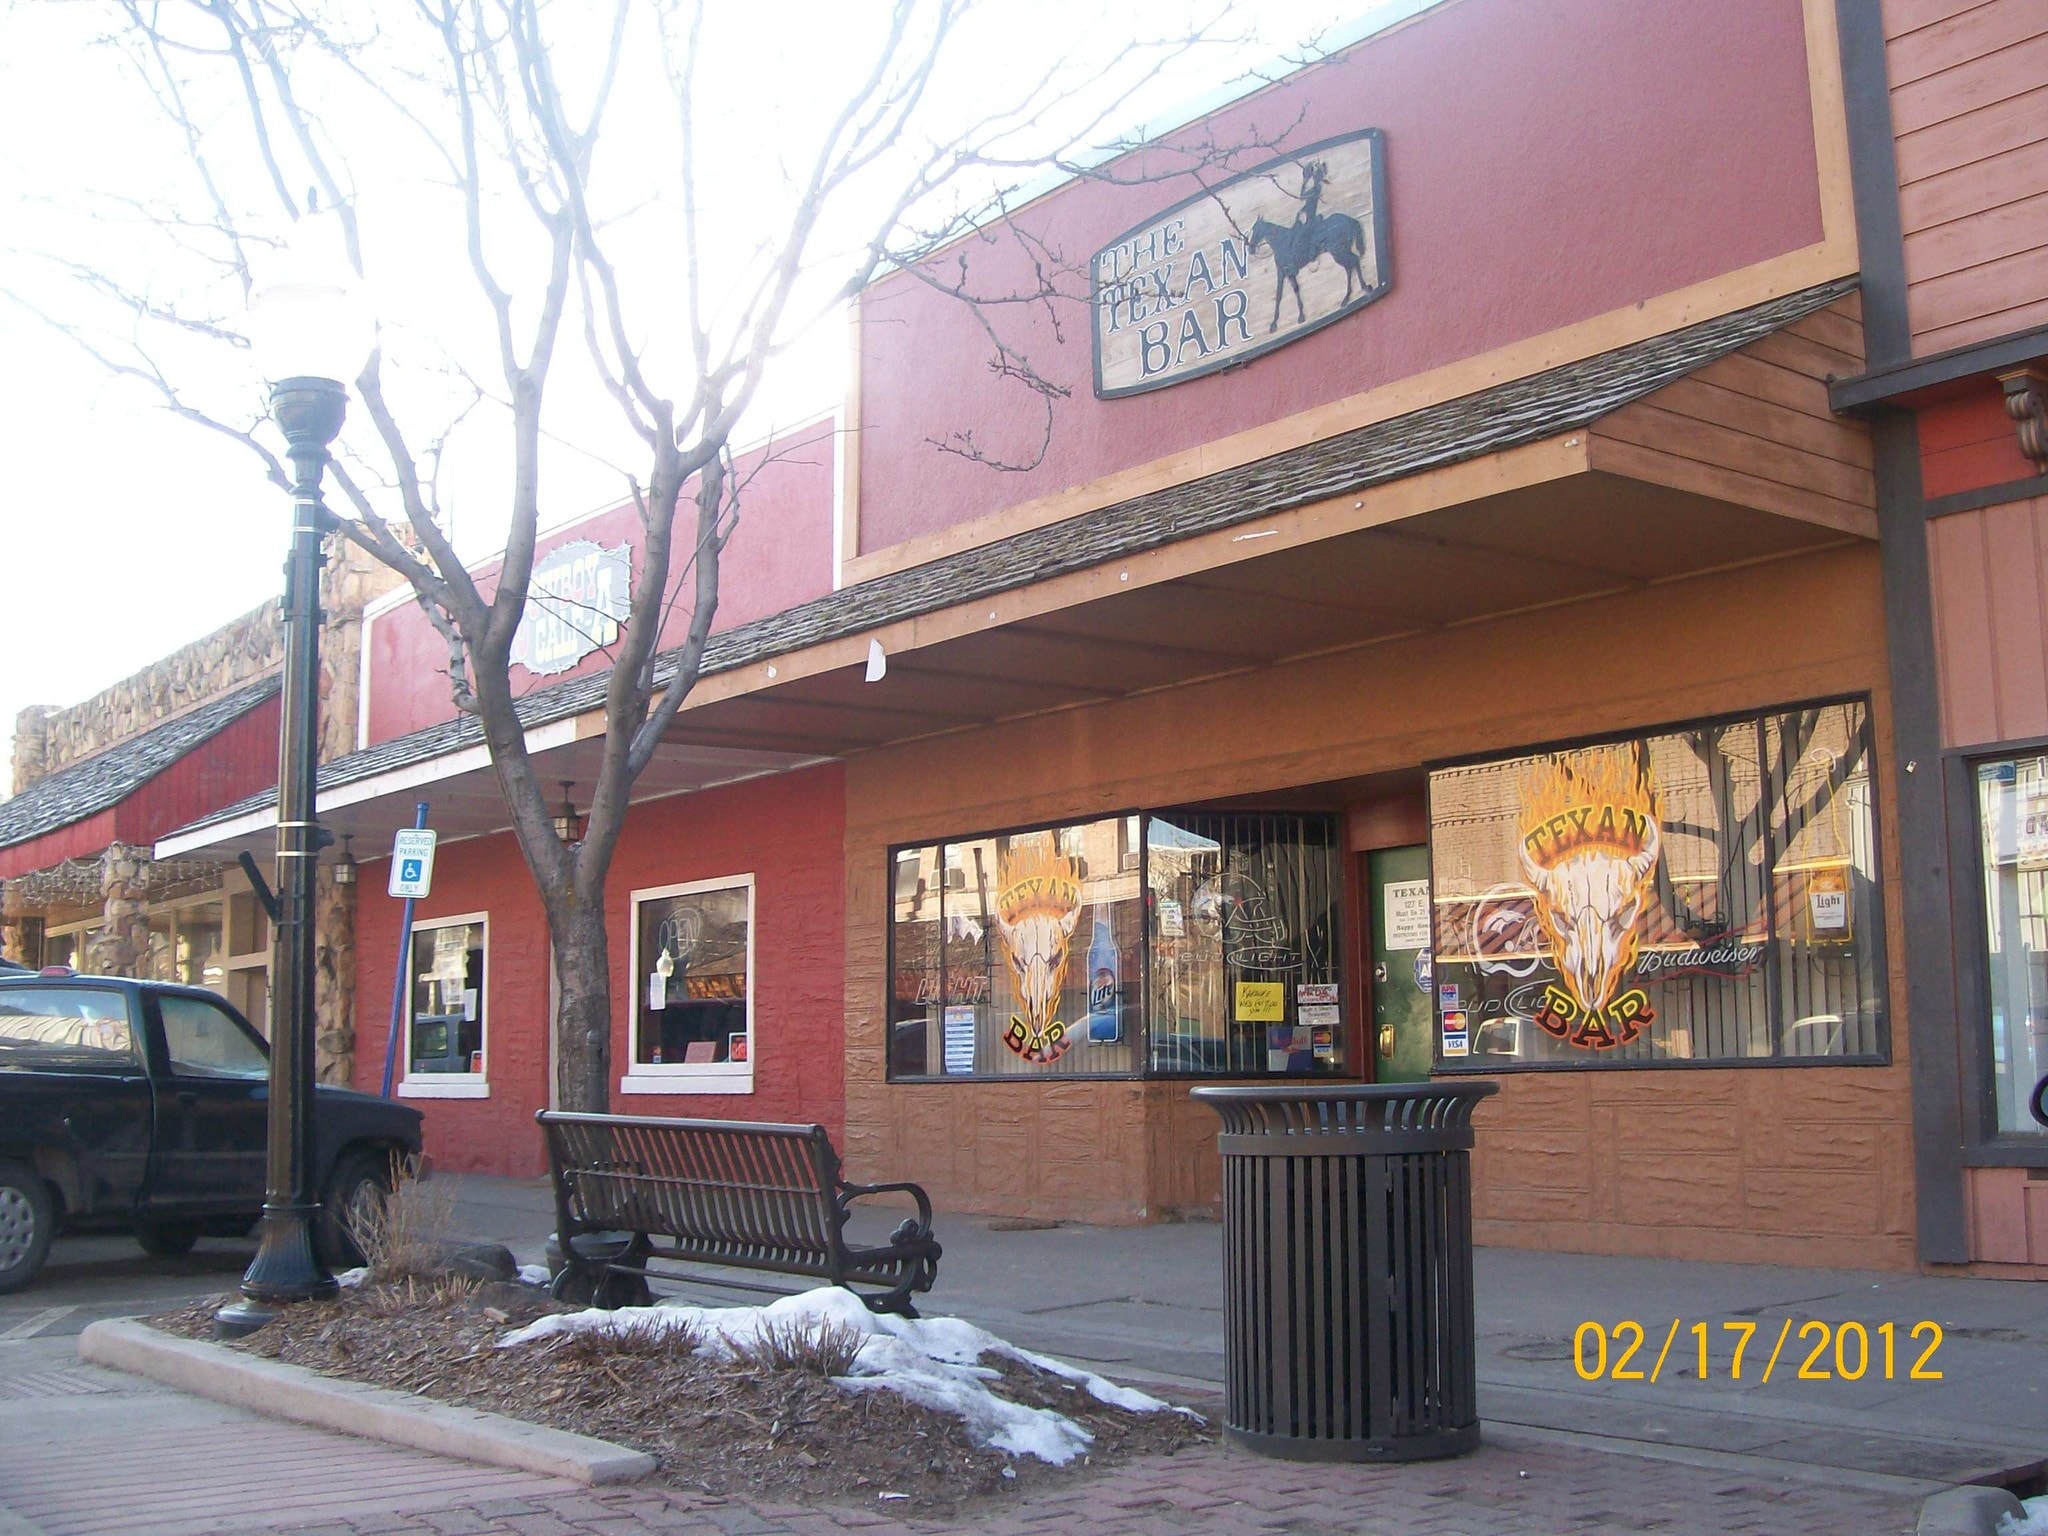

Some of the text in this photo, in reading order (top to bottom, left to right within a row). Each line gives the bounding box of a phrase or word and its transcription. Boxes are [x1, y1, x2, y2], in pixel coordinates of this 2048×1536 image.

[1101, 217, 1185, 281] THE
[1101, 232, 1248, 335] TEXAN
[1139, 289, 1253, 380] BAR
[399, 848, 429, 857] PARKING
[1523, 805, 1648, 865] TEXAN
[400, 884, 418, 893] ONLY
[1000, 877, 1080, 922] TEXAN
[1638, 943, 1764, 974] Budweiser
[1003, 1015, 1071, 1064] BAR
[1535, 986, 1656, 1049] BAR
